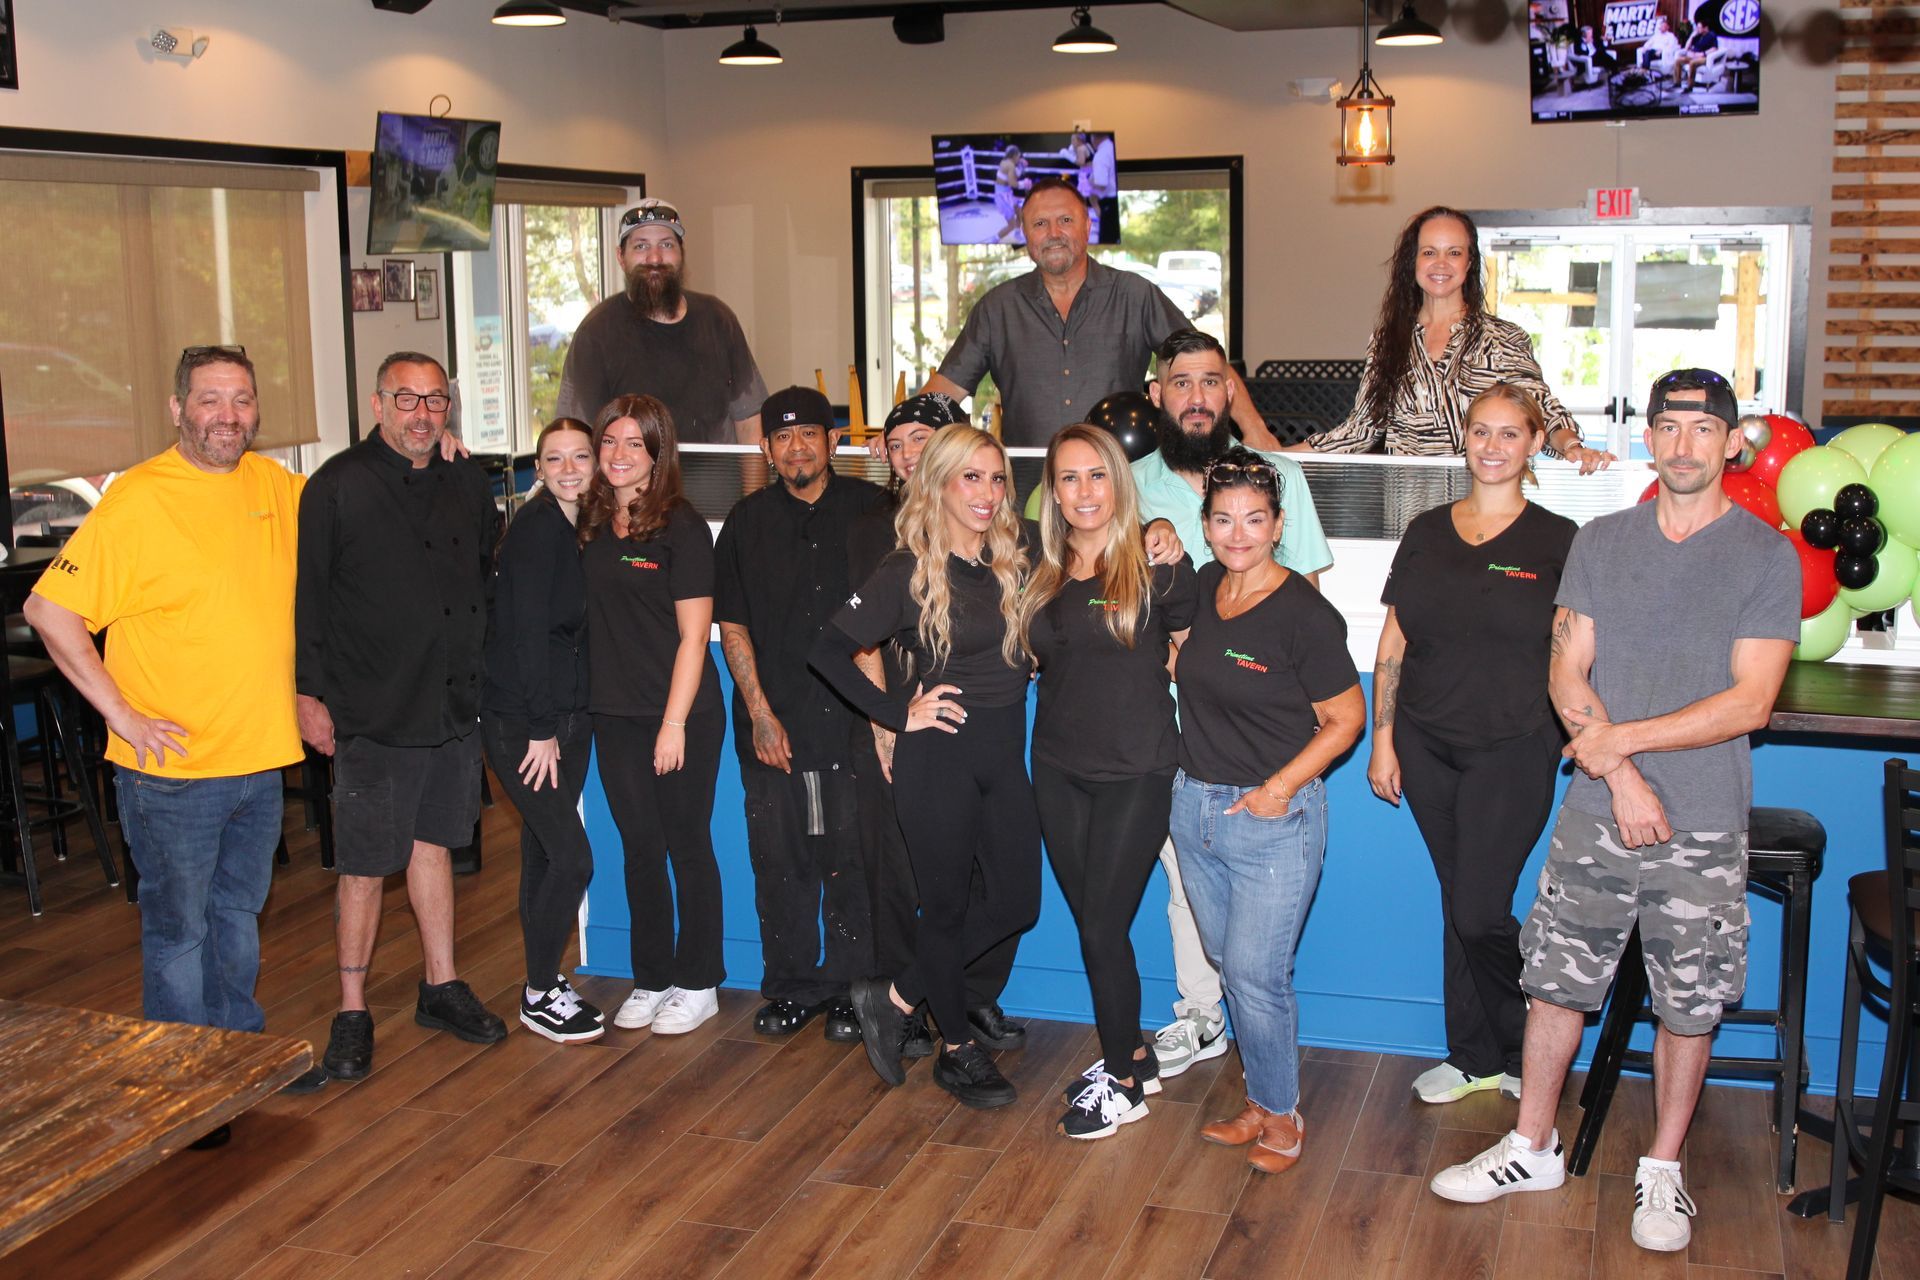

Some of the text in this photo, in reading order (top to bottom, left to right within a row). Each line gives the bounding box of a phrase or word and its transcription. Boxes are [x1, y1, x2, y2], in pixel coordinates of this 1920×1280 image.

[1606, 5, 1654, 24] MARTY
[1723, 0, 1758, 31] SEC
[1597, 188, 1632, 217] EXIT
[51, 554, 79, 577] ite
[632, 561, 658, 569] TAVERN
[1505, 570, 1537, 579] TAVERN
[1236, 658, 1268, 673] TAVERN
